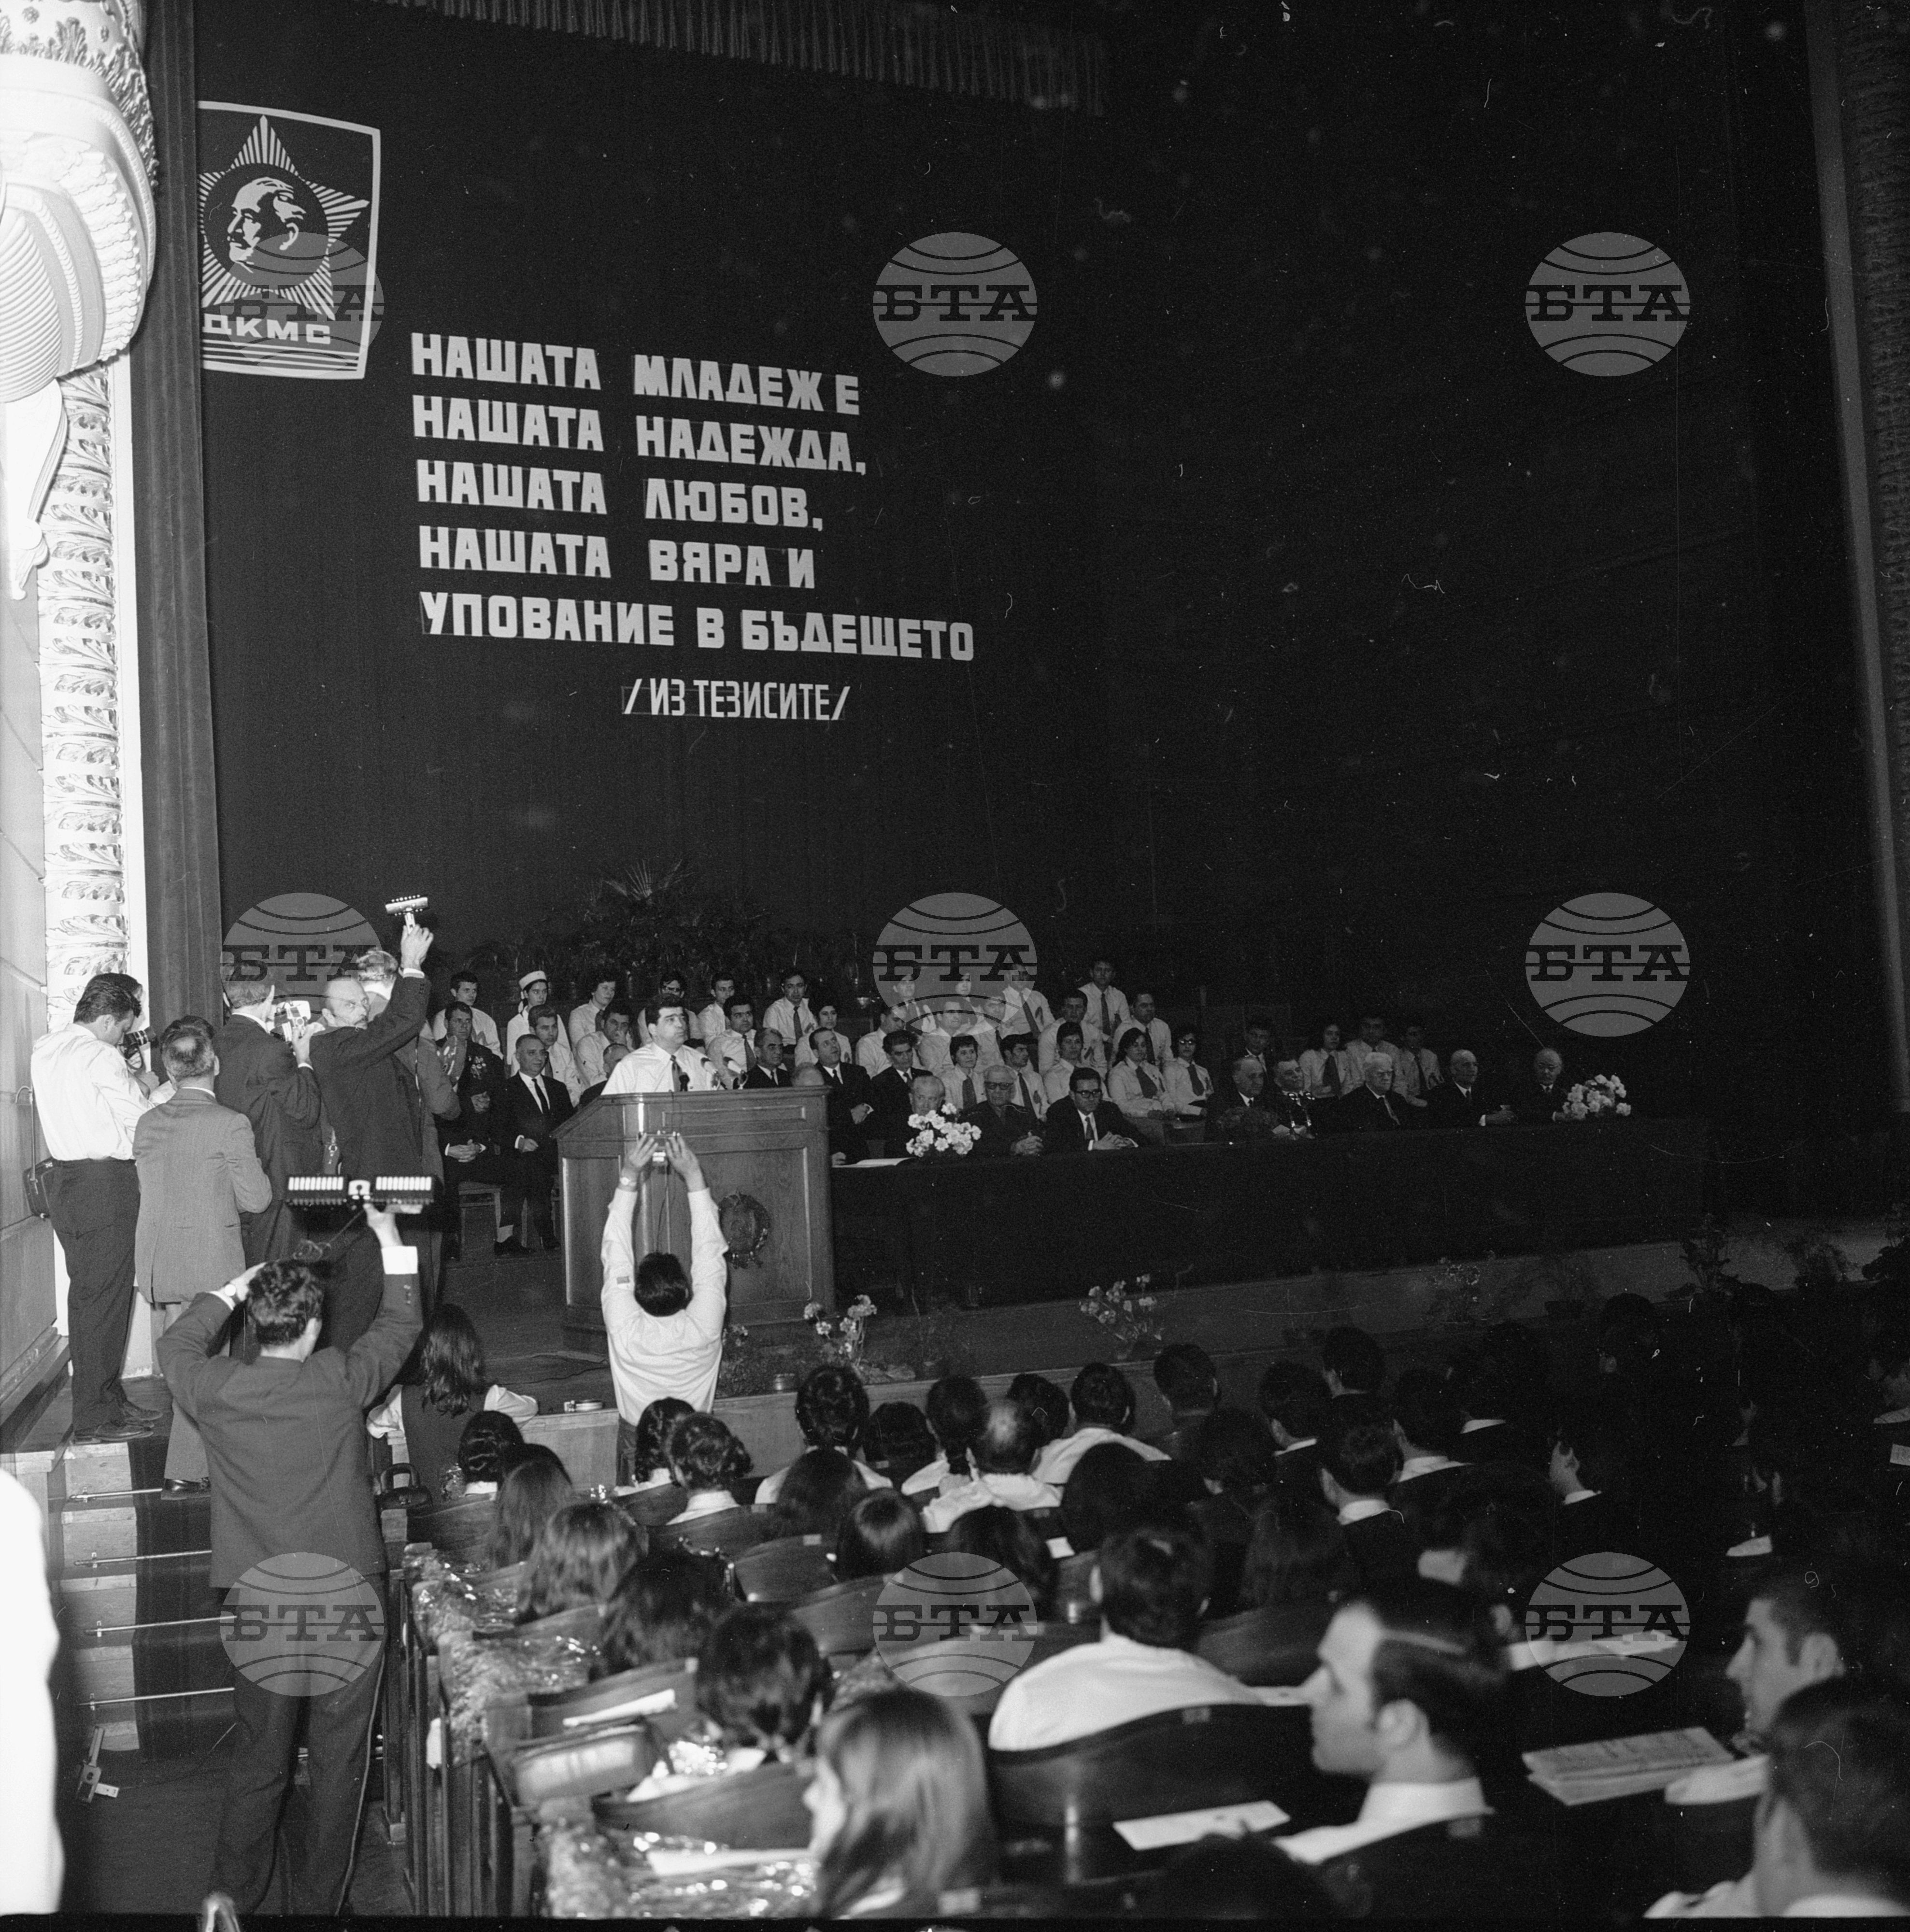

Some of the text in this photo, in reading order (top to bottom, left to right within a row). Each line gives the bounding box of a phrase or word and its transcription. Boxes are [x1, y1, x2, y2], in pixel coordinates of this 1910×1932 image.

[202, 313, 331, 344] ДКМС
[412, 332, 859, 415] НАШАТА МЛАДЕЖ Е
[412, 395, 866, 476] НАШАТА НАДЕЖДА,
[416, 459, 823, 532] НАШАТА ЛЮБОВ,
[419, 525, 815, 589] НАШАТА ВЯРА И
[420, 591, 974, 661] УПОВАНИЕ В БЪДЕЩЕТО
